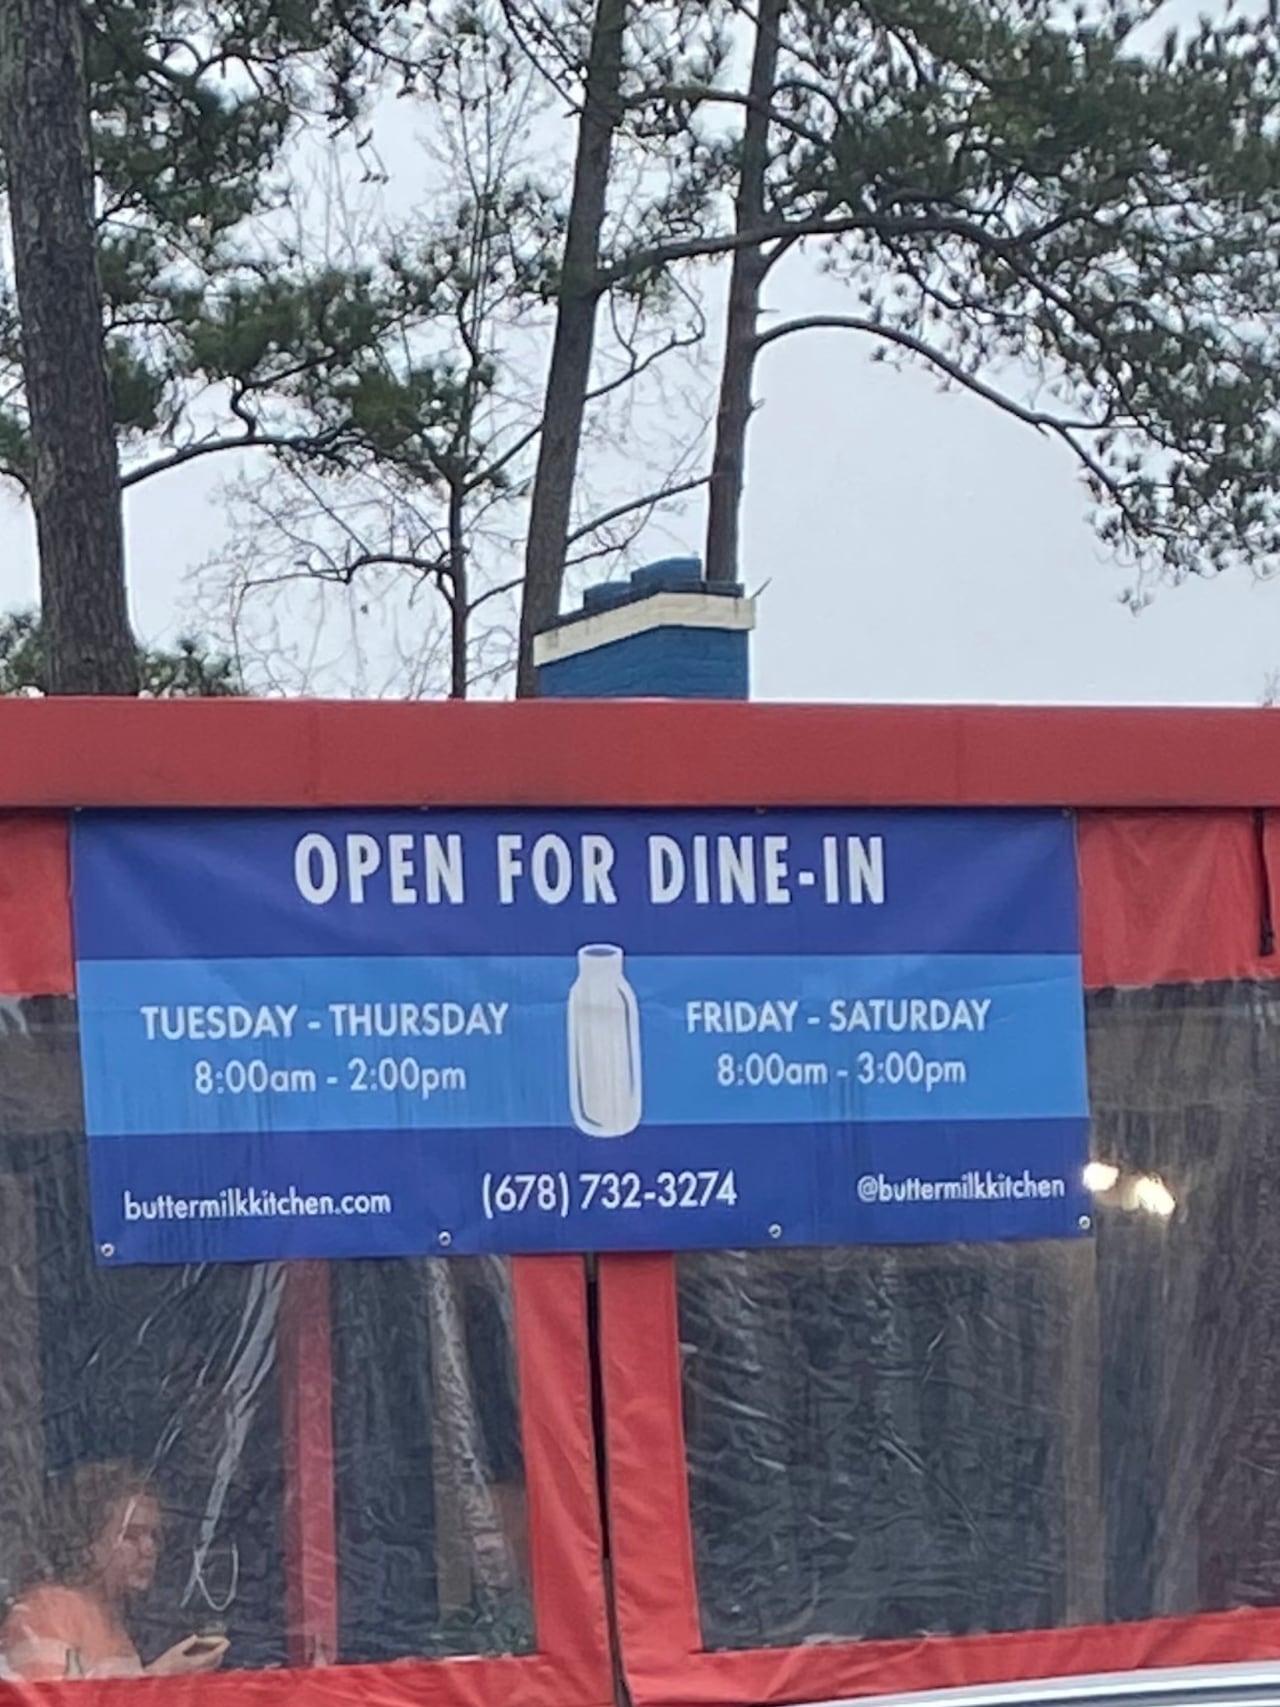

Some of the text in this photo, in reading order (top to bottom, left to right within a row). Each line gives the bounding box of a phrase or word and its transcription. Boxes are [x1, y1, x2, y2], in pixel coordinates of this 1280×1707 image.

[295, 834, 886, 905] OPEN FOR DINE-IN
[140, 1005, 297, 1039] TUESDAY
[329, 1004, 508, 1037] THURSDAY
[687, 1000, 798, 1034] FRIDAY
[829, 999, 991, 1033] SATURDAY
[194, 1060, 316, 1095] 8:00am
[348, 1058, 466, 1101] 2:00pm
[718, 1053, 827, 1087] 8:00am
[857, 1054, 967, 1096] 3:00pm
[124, 1188, 391, 1222] buttermilkkitchen.com
[482, 1172, 737, 1216] (678) 732-3274
[858, 1172, 1065, 1203] @buttermilkkitchen
